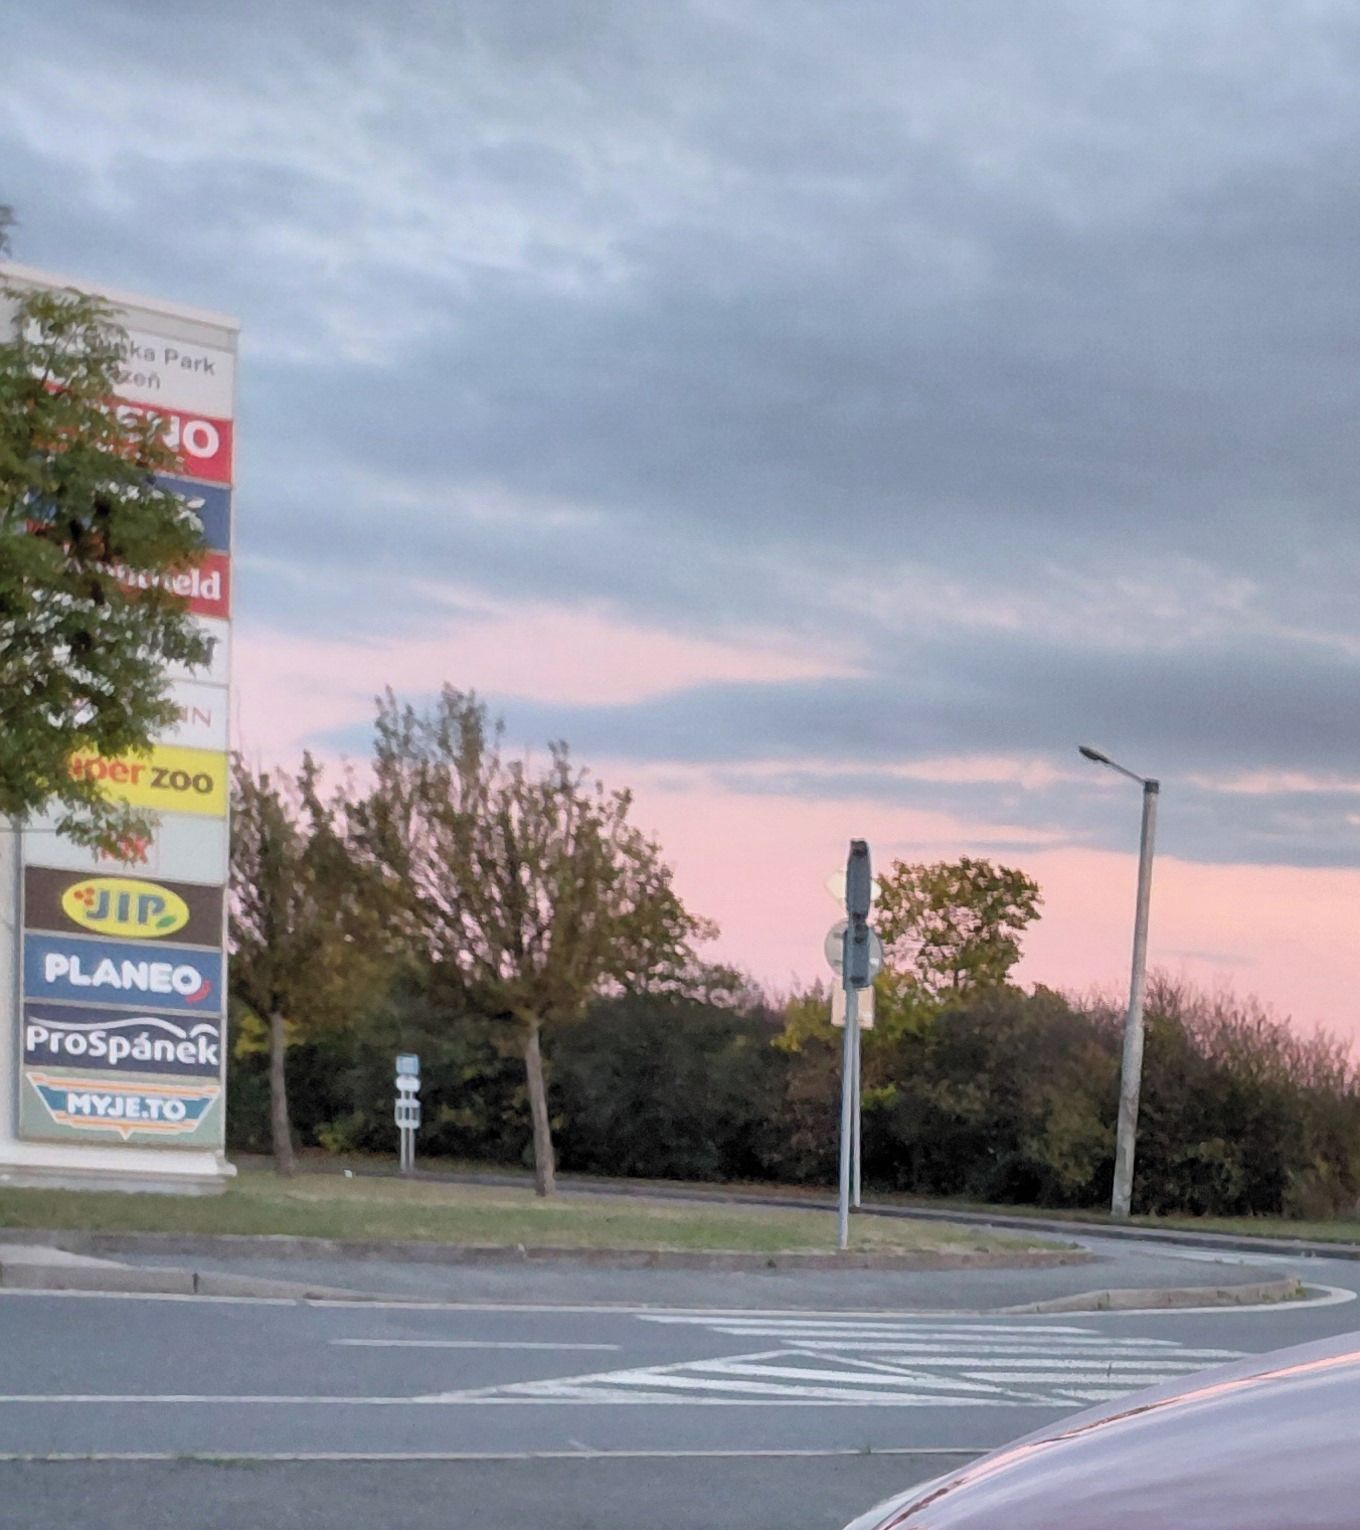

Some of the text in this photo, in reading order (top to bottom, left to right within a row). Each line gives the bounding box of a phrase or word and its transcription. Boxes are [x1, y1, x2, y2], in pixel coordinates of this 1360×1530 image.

[164, 348, 216, 376] Park
[150, 766, 214, 795] zoo
[86, 889, 165, 924] JIP
[44, 952, 202, 995] PLANEO
[26, 1025, 219, 1065] ProSpánek
[66, 1092, 187, 1121] MYJE.TO
